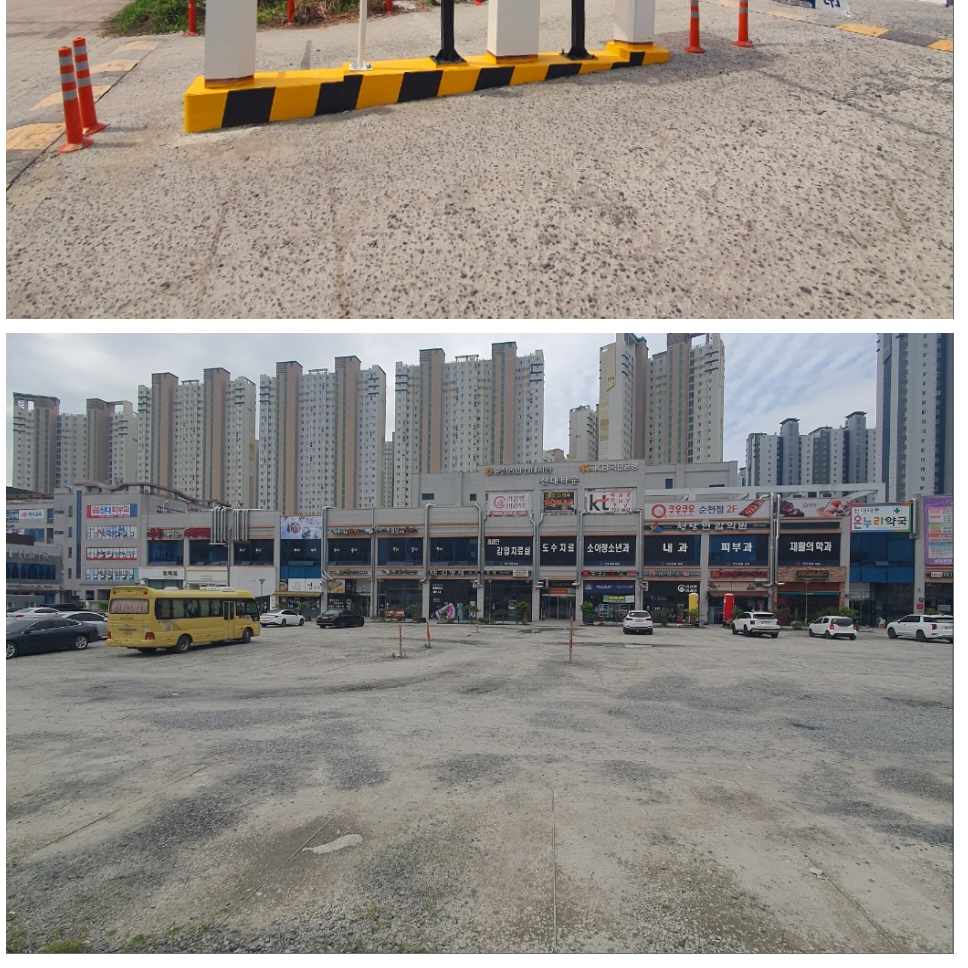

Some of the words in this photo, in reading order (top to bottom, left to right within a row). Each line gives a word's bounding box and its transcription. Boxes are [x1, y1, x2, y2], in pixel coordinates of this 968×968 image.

[540, 476, 579, 486] 신대타운
[589, 494, 609, 511] kt
[668, 504, 695, 515] 쿠우쿠우
[698, 505, 724, 514] 순천점
[727, 505, 738, 513] 2F
[853, 514, 908, 529] 온누리약국
[496, 546, 531, 556] 감압치료실
[542, 543, 574, 553] 도수치료
[586, 543, 630, 553] 소아청소년과
[662, 542, 688, 553] 내과
[720, 542, 753, 552] 피부과
